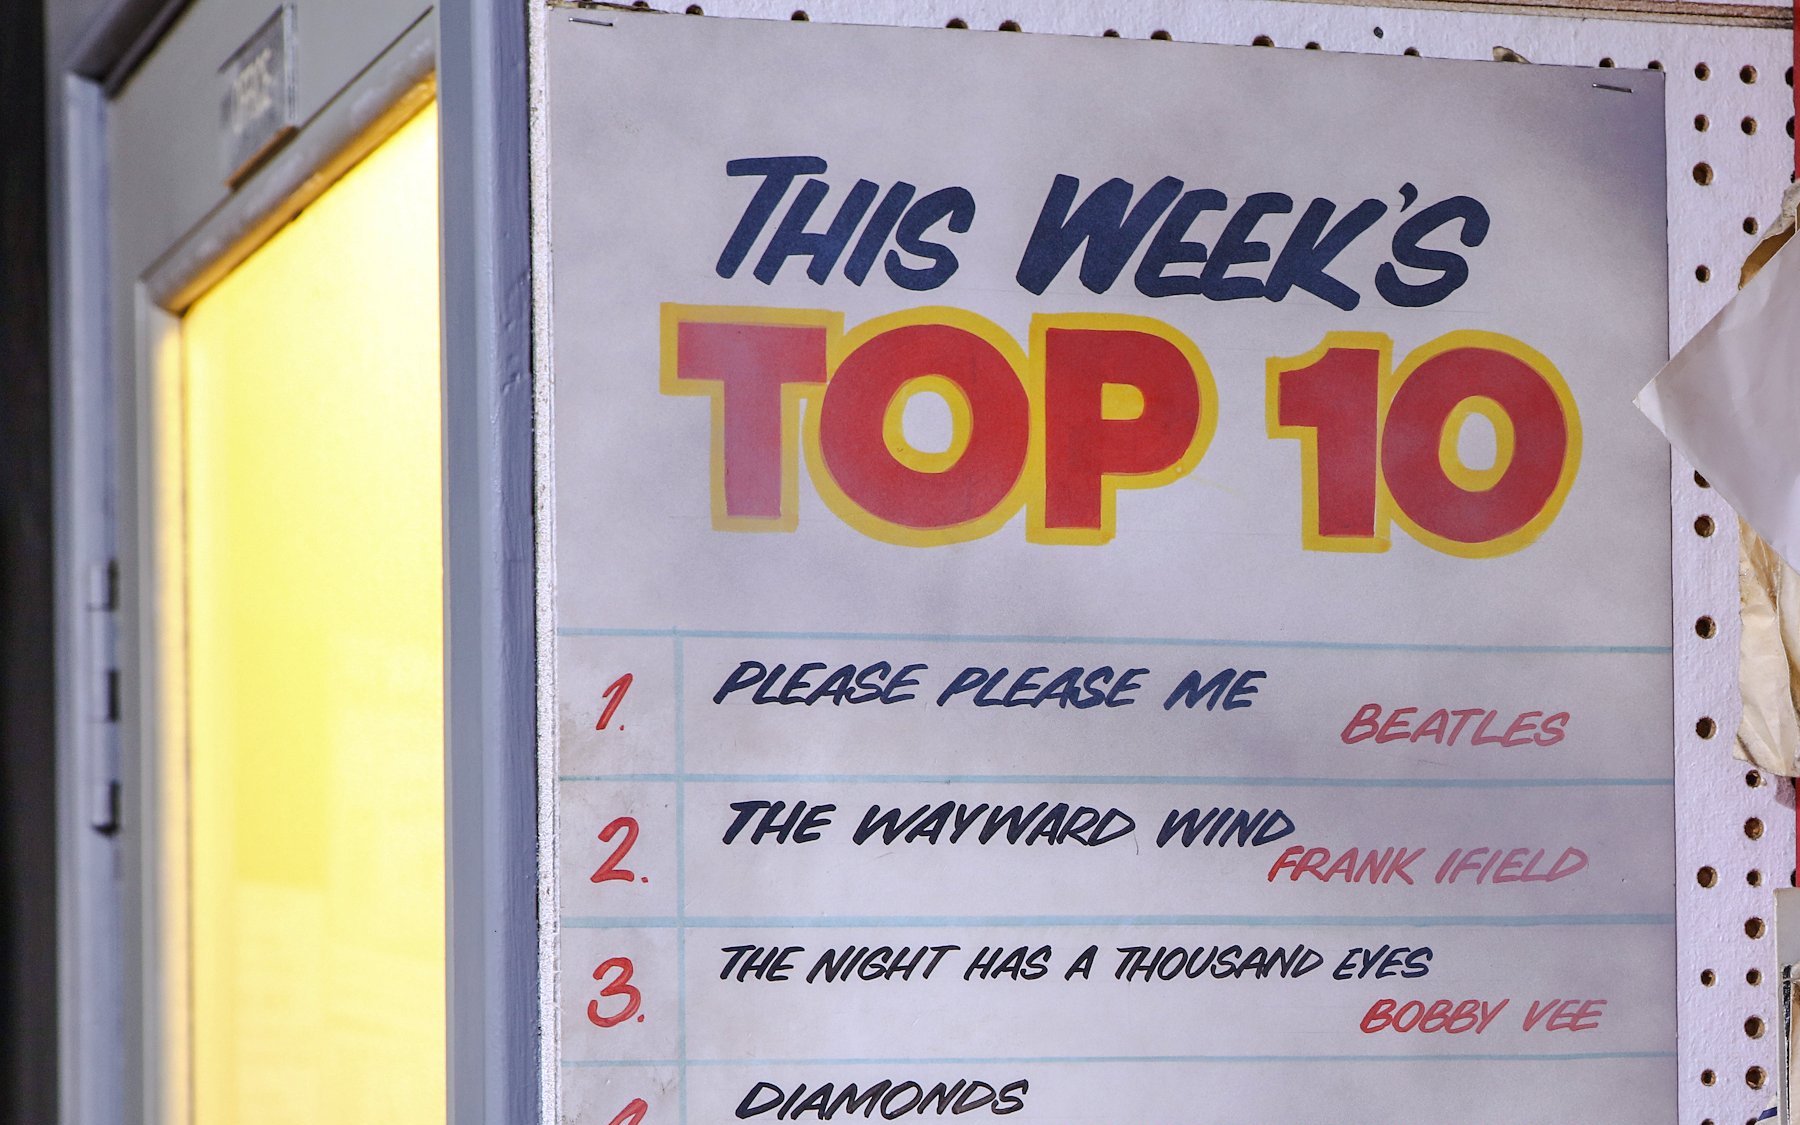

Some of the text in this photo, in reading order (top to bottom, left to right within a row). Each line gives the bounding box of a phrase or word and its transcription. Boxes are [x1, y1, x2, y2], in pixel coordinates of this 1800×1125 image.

[715, 155, 1491, 312] THIS WEEK'S
[659, 302, 1583, 560] TOP 10
[595, 672, 634, 731] 1.
[712, 660, 1268, 712] PLEASE PLEASE ME
[1340, 703, 1570, 748] BEATLES
[589, 815, 649, 884] 2.
[721, 800, 1297, 849] THE WAYWARD WIND
[1267, 844, 1586, 885] FRANK IFIELD
[719, 943, 1434, 985] THE NIGHT HAS A THOUSAND EYES
[586, 956, 646, 1028] 3.
[1359, 998, 1605, 1035] BOBBY VEE
[734, 1078, 1030, 1121] DIAMONDS
